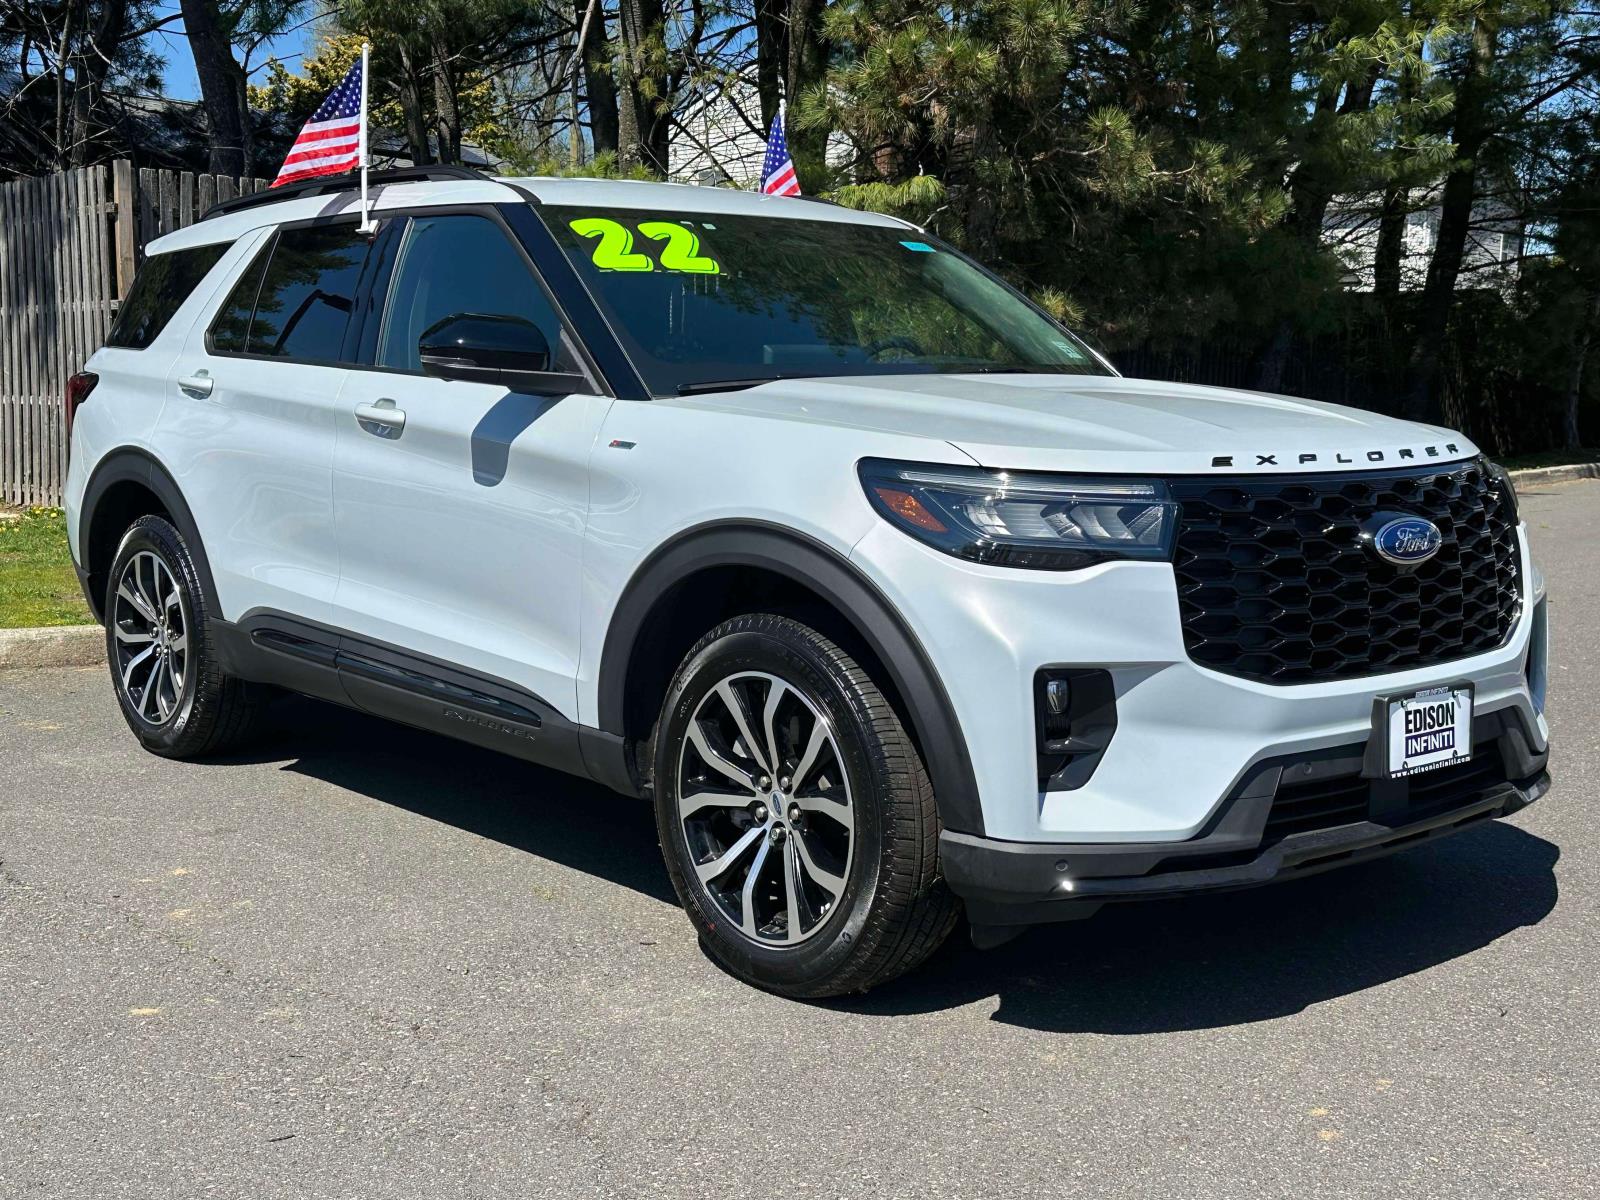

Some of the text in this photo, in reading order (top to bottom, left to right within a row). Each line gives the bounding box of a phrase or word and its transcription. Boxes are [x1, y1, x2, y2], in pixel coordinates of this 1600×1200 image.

[569, 218, 720, 274] 22
[1211, 443, 1459, 468] EXPLORER
[1395, 527, 1431, 553] Ford
[1404, 701, 1455, 735] EDISON
[1408, 730, 1453, 755] INFINITI
[1391, 756, 1471, 779] www.edisoninfiniti.com
